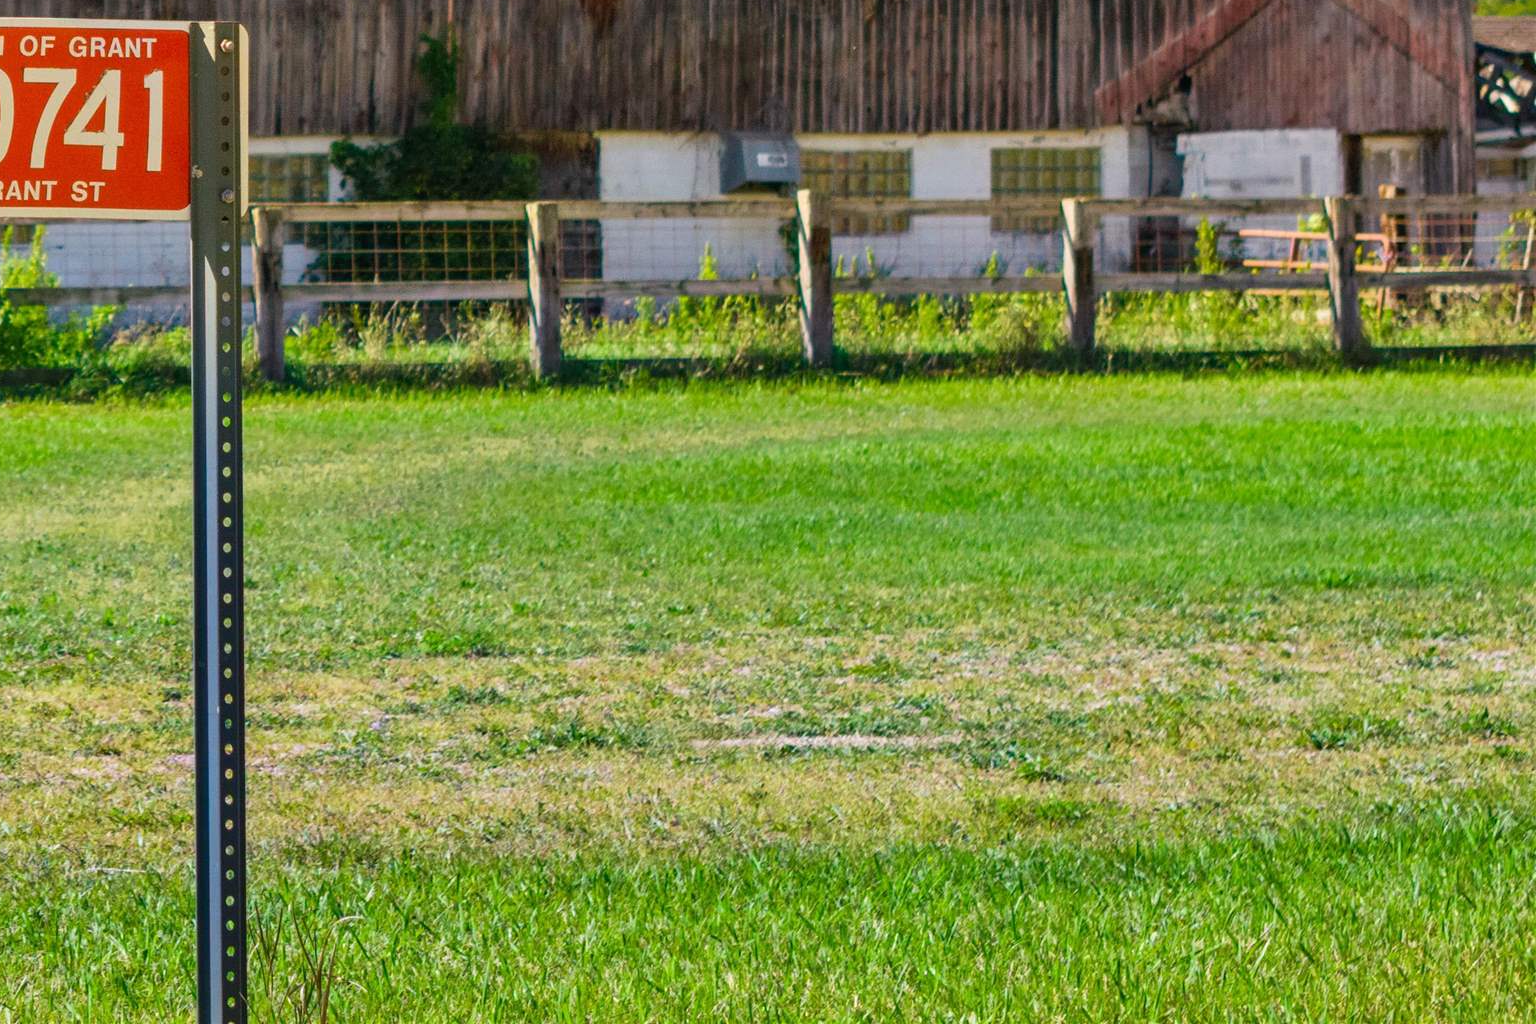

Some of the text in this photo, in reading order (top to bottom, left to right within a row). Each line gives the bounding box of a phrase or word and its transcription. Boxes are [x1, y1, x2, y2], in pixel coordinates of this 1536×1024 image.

[19, 34, 56, 57] OF
[68, 36, 158, 59] GRANT
[70, 180, 106, 202] ST
